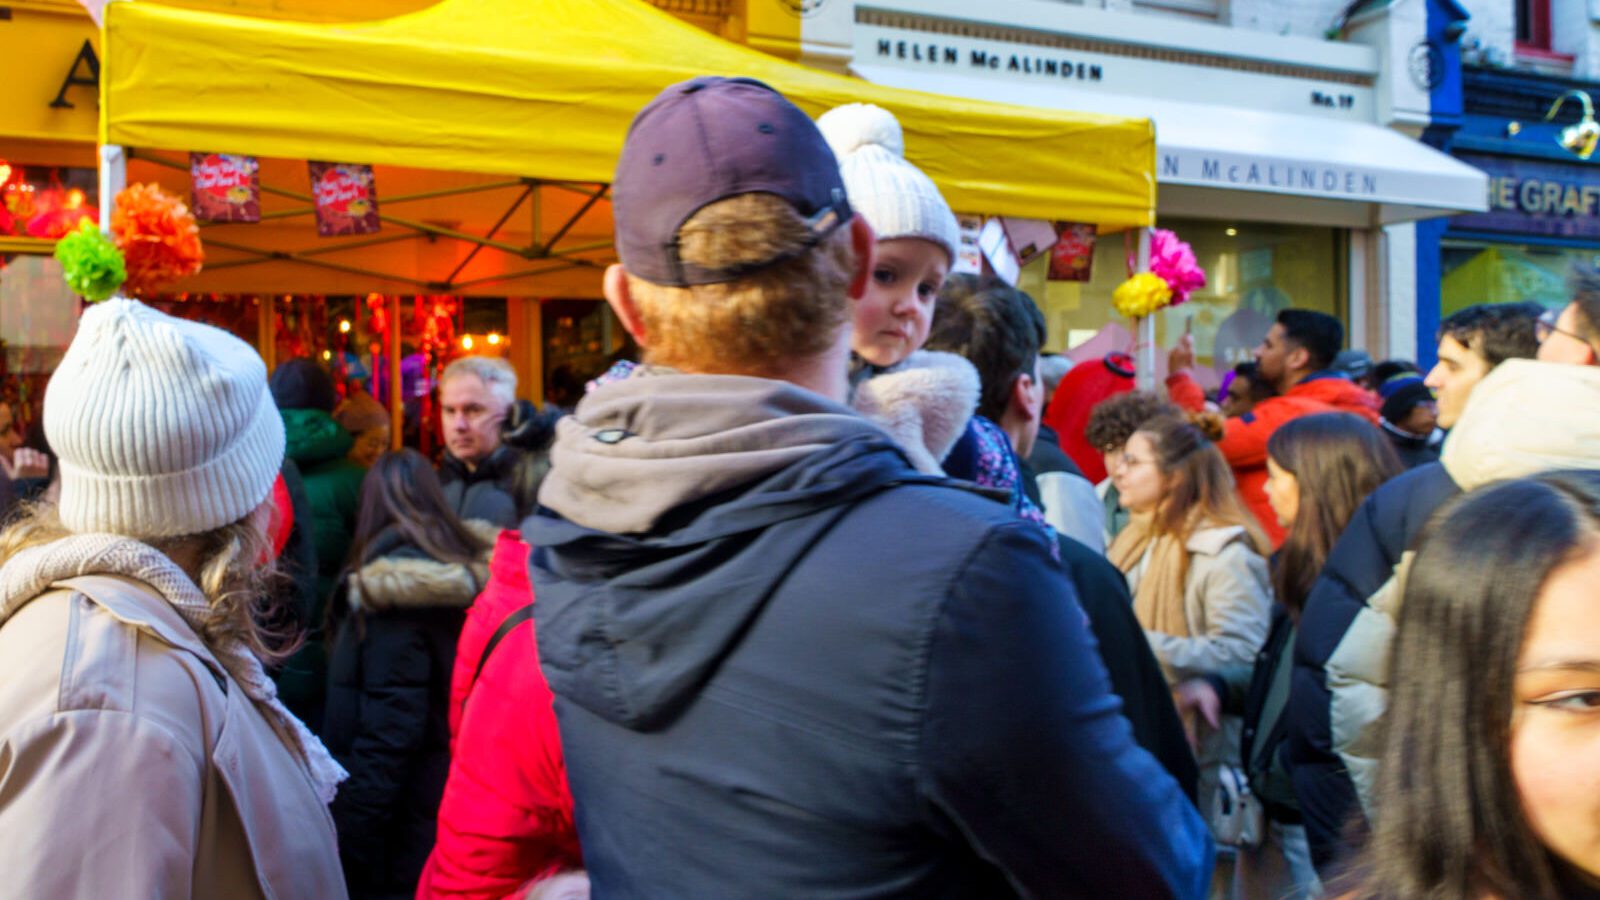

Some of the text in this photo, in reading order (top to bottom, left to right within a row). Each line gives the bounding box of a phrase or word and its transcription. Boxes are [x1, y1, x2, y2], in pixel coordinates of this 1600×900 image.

[877, 38, 1103, 81] HELEN Mc ALINDEN
[1202, 157, 1377, 194] McALINDEN
